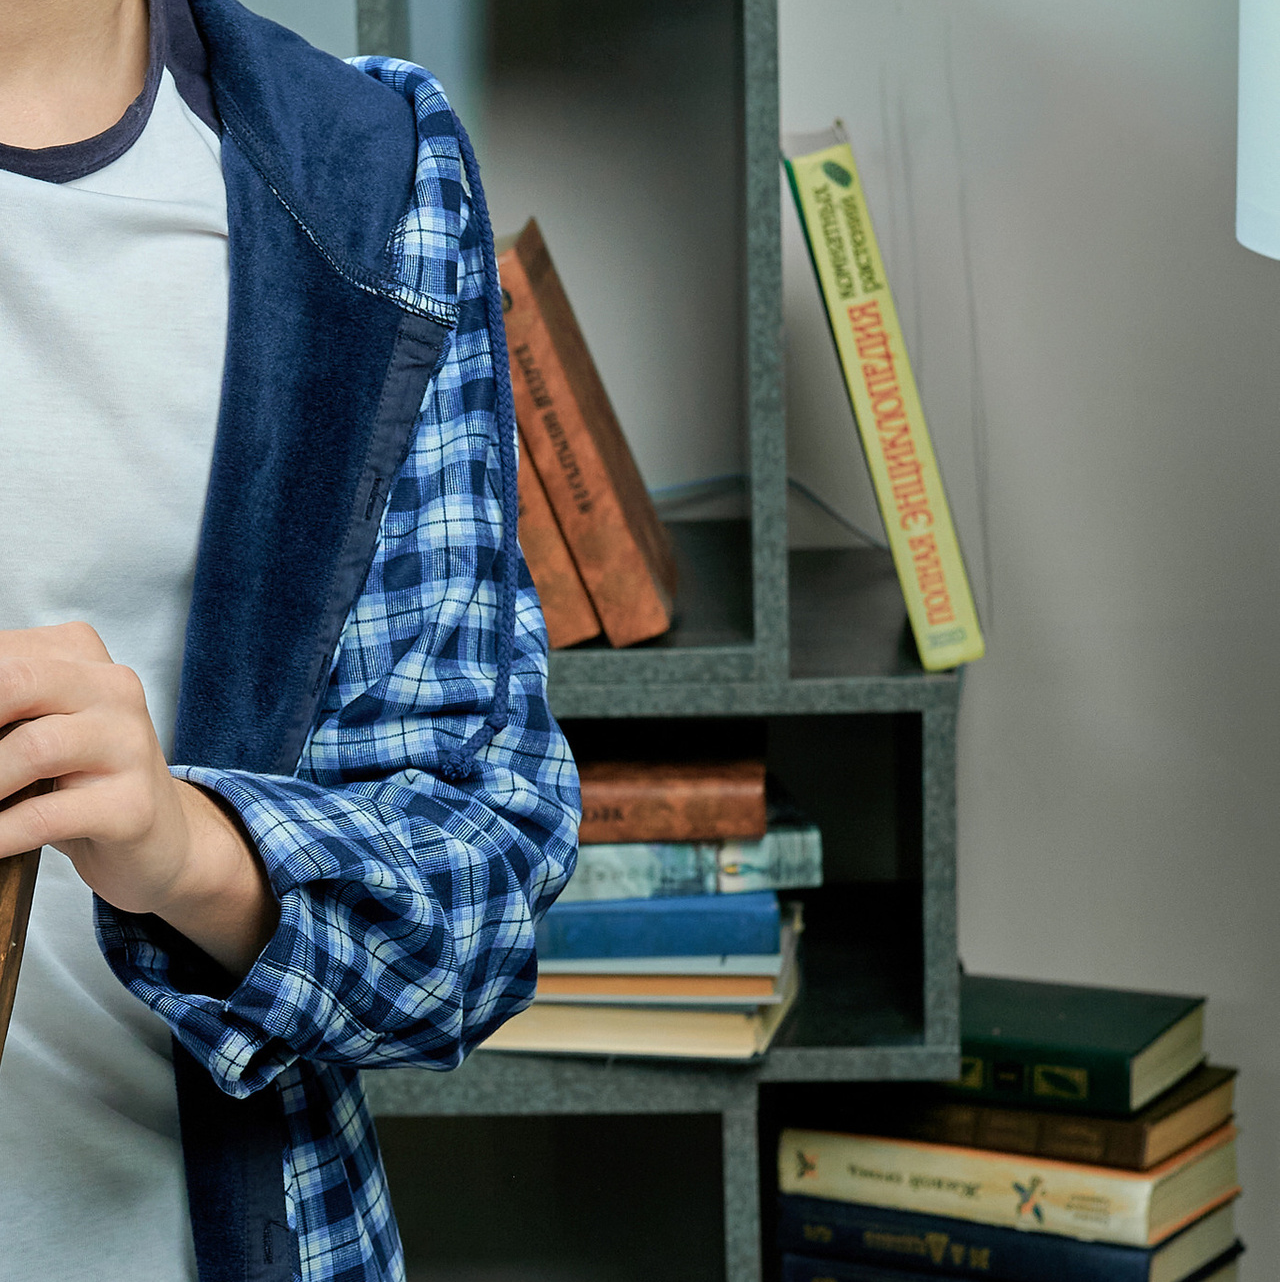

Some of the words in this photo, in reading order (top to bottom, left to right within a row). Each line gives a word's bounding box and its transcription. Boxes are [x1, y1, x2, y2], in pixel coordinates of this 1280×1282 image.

[812, 184, 856, 300] комнатных
[839, 194, 885, 294] растений
[847, 300, 935, 531] ЭНЦИКЛОПЕДИЯ
[908, 532, 955, 626] ПОЛНАЯ
